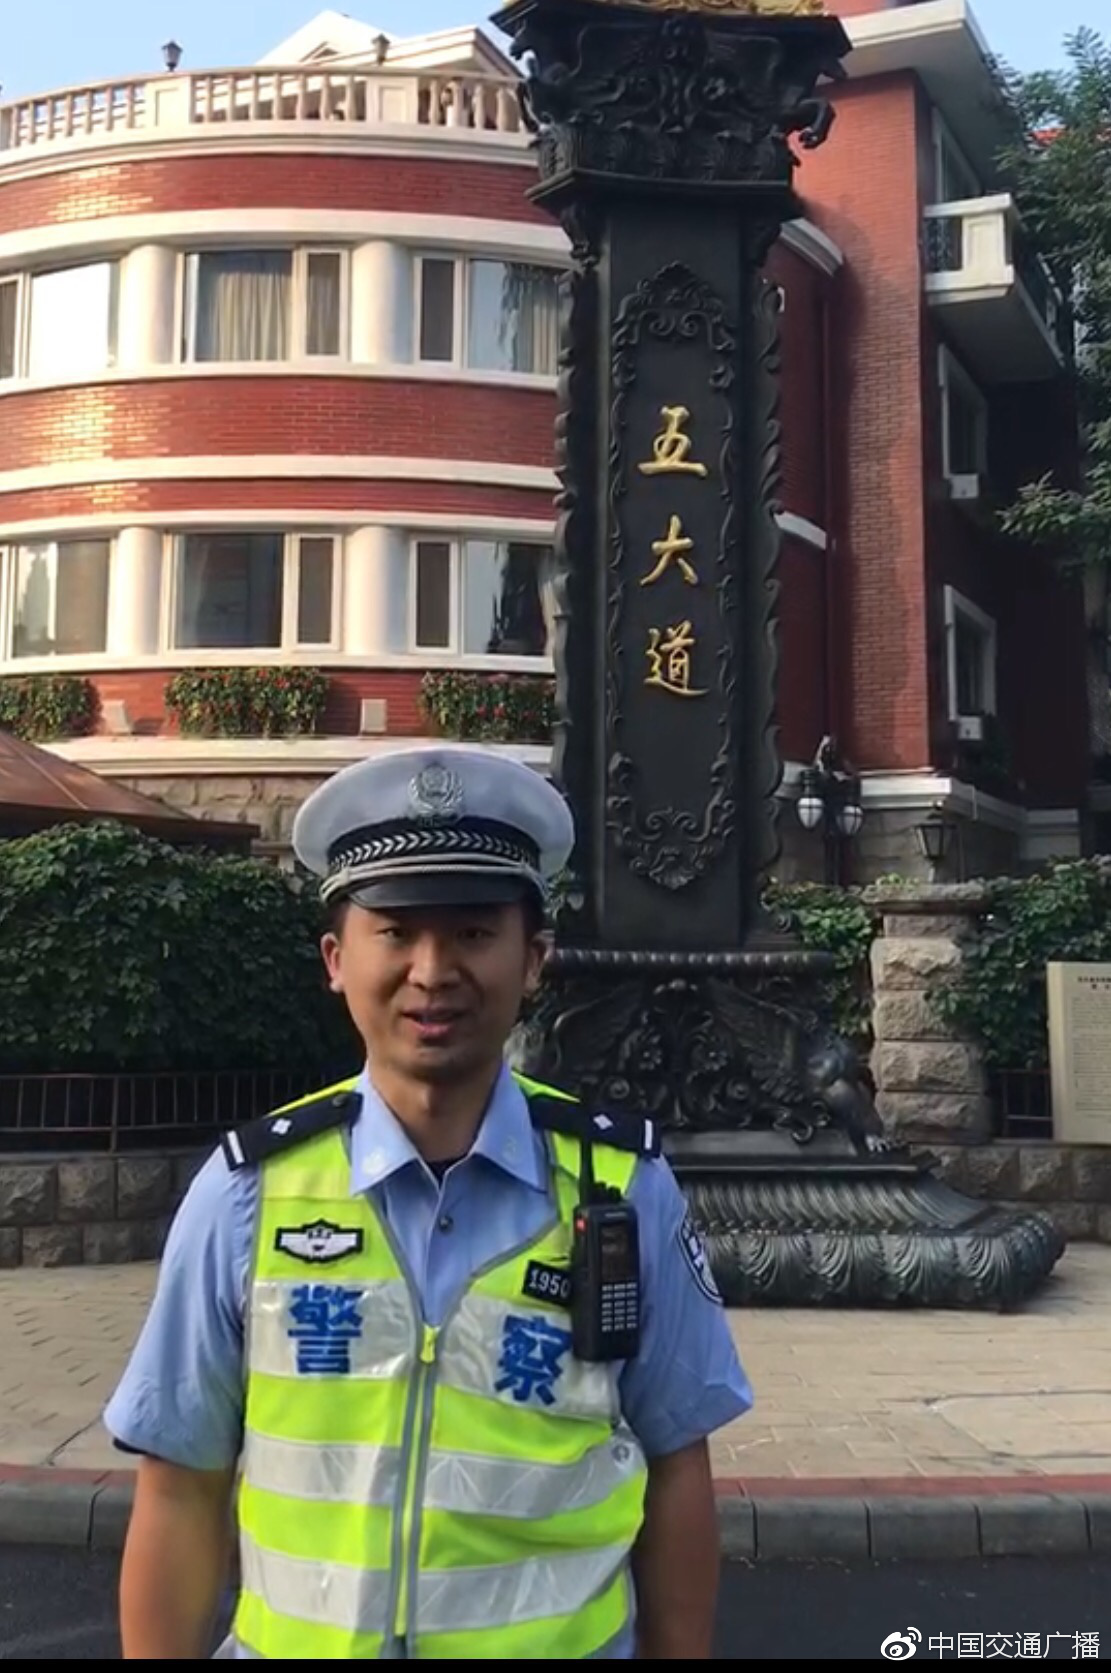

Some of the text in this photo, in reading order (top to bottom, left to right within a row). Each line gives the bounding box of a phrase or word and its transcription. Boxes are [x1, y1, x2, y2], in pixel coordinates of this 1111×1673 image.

[637, 404, 709, 698] 五大道
[287, 1284, 573, 1406] 警 察
